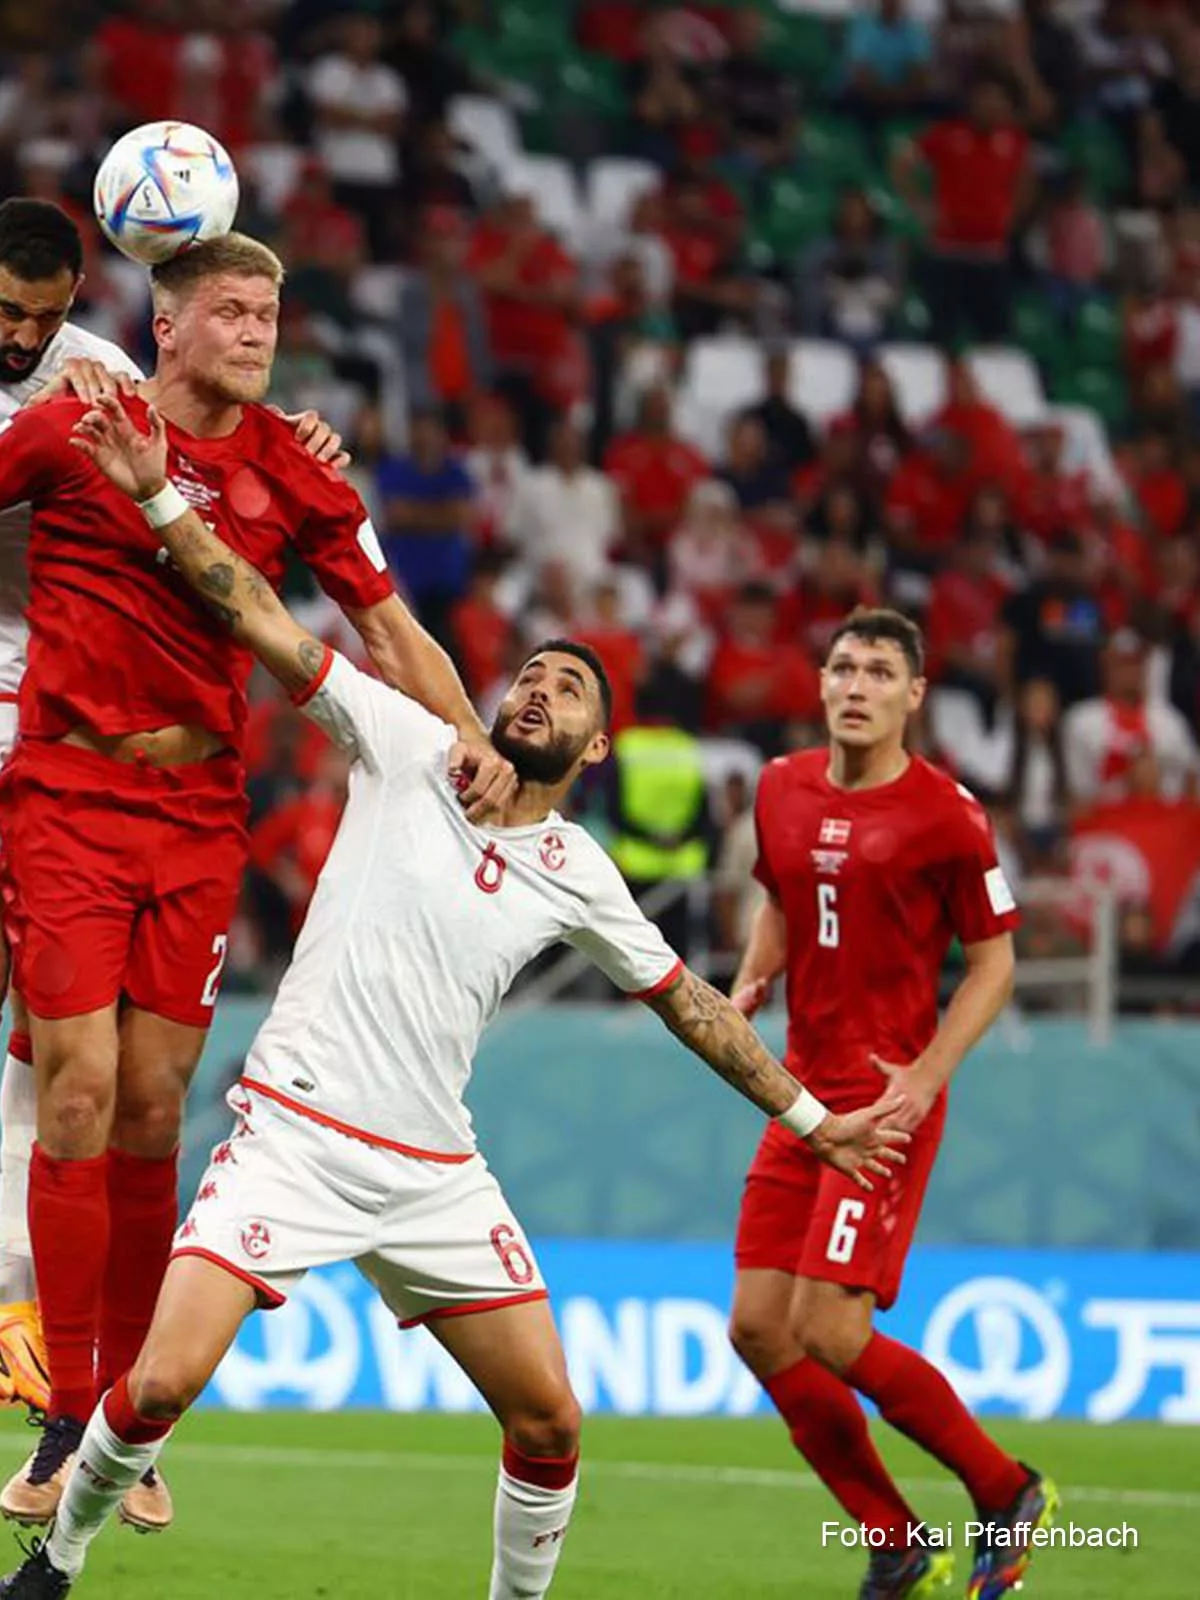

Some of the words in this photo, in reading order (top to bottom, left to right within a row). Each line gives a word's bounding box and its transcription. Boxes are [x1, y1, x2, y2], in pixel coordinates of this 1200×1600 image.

[817, 883, 839, 949] 6
[490, 1223, 533, 1285] 6
[826, 1198, 865, 1264] 6
[368, 1296, 766, 1415] WND
